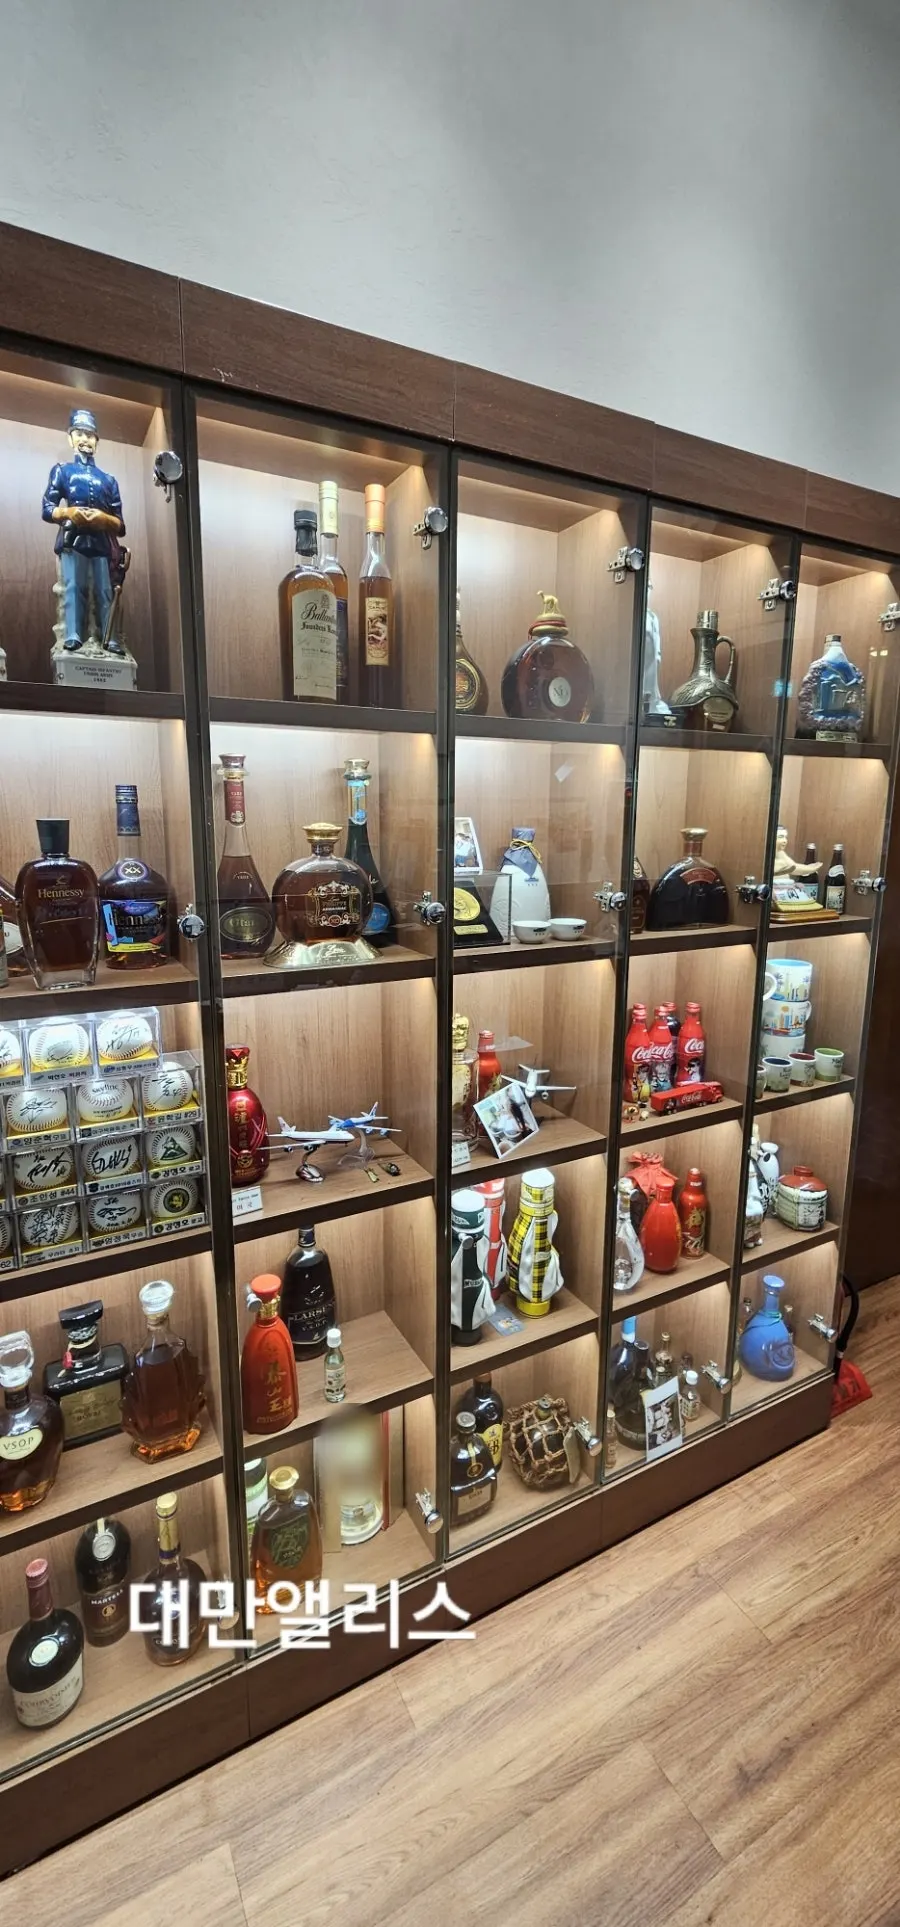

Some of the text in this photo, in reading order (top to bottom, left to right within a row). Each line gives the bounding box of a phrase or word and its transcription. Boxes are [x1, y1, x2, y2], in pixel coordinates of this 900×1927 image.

[38, 888, 85, 898] Hennessy
[30, 1188, 75, 1203] 조인성 #44
